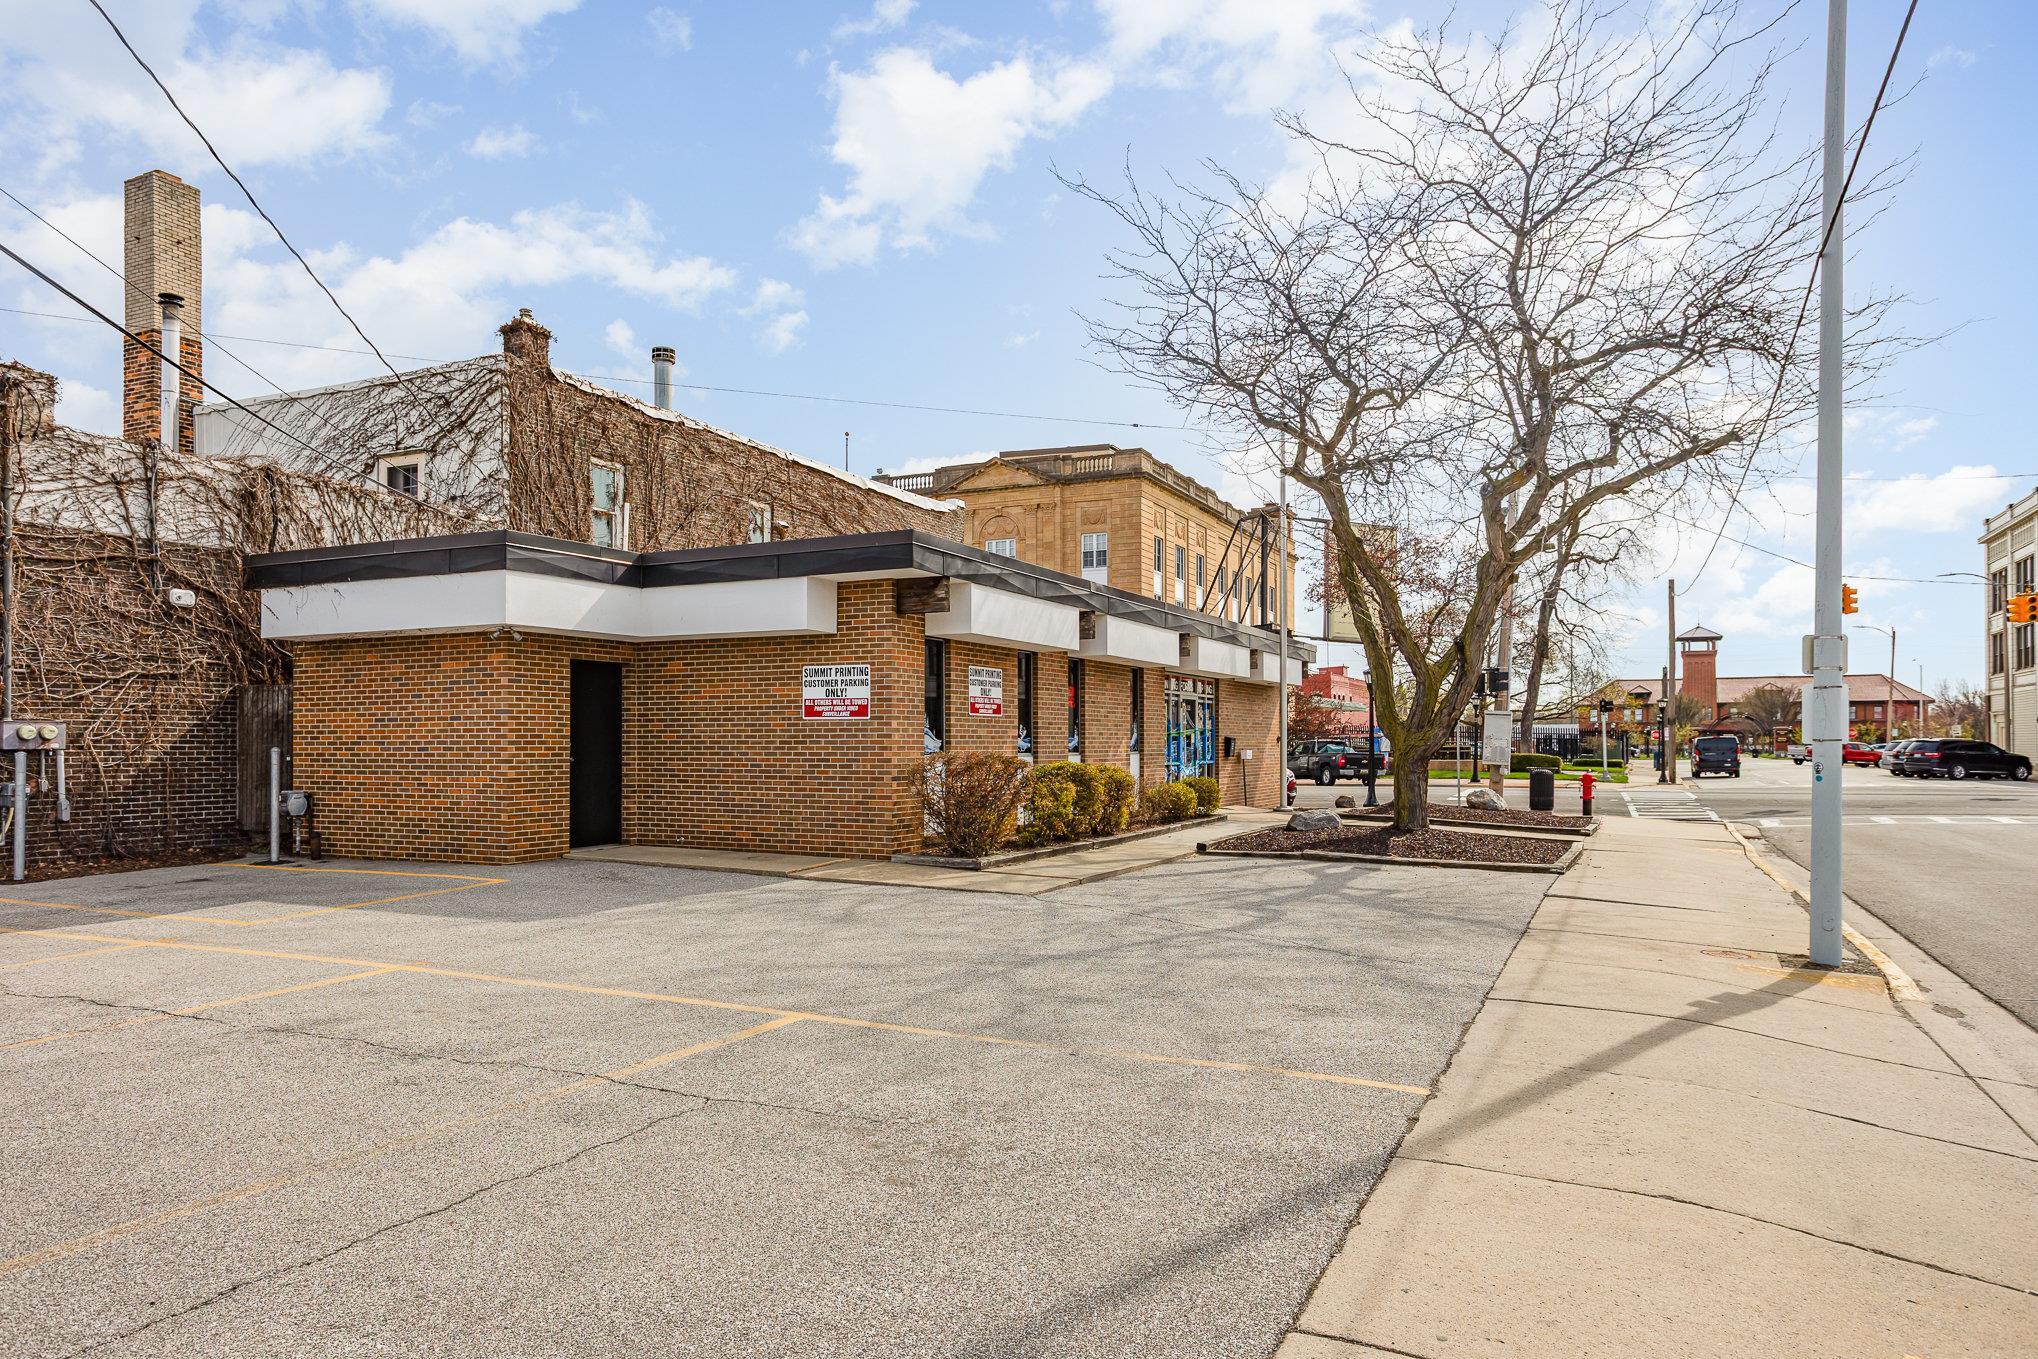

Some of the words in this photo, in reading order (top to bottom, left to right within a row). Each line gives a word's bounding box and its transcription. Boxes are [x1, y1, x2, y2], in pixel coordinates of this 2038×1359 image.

[804, 668, 833, 678] SUMMIT
[835, 666, 869, 677] PRINTING
[970, 668, 984, 677] SUMMIT
[985, 669, 1001, 679] PRINTING
[804, 679, 839, 687] CUSTOMER
[841, 678, 869, 687] PARKING
[970, 679, 987, 687] CUSTOMER
[825, 688, 847, 697] ONLY!
